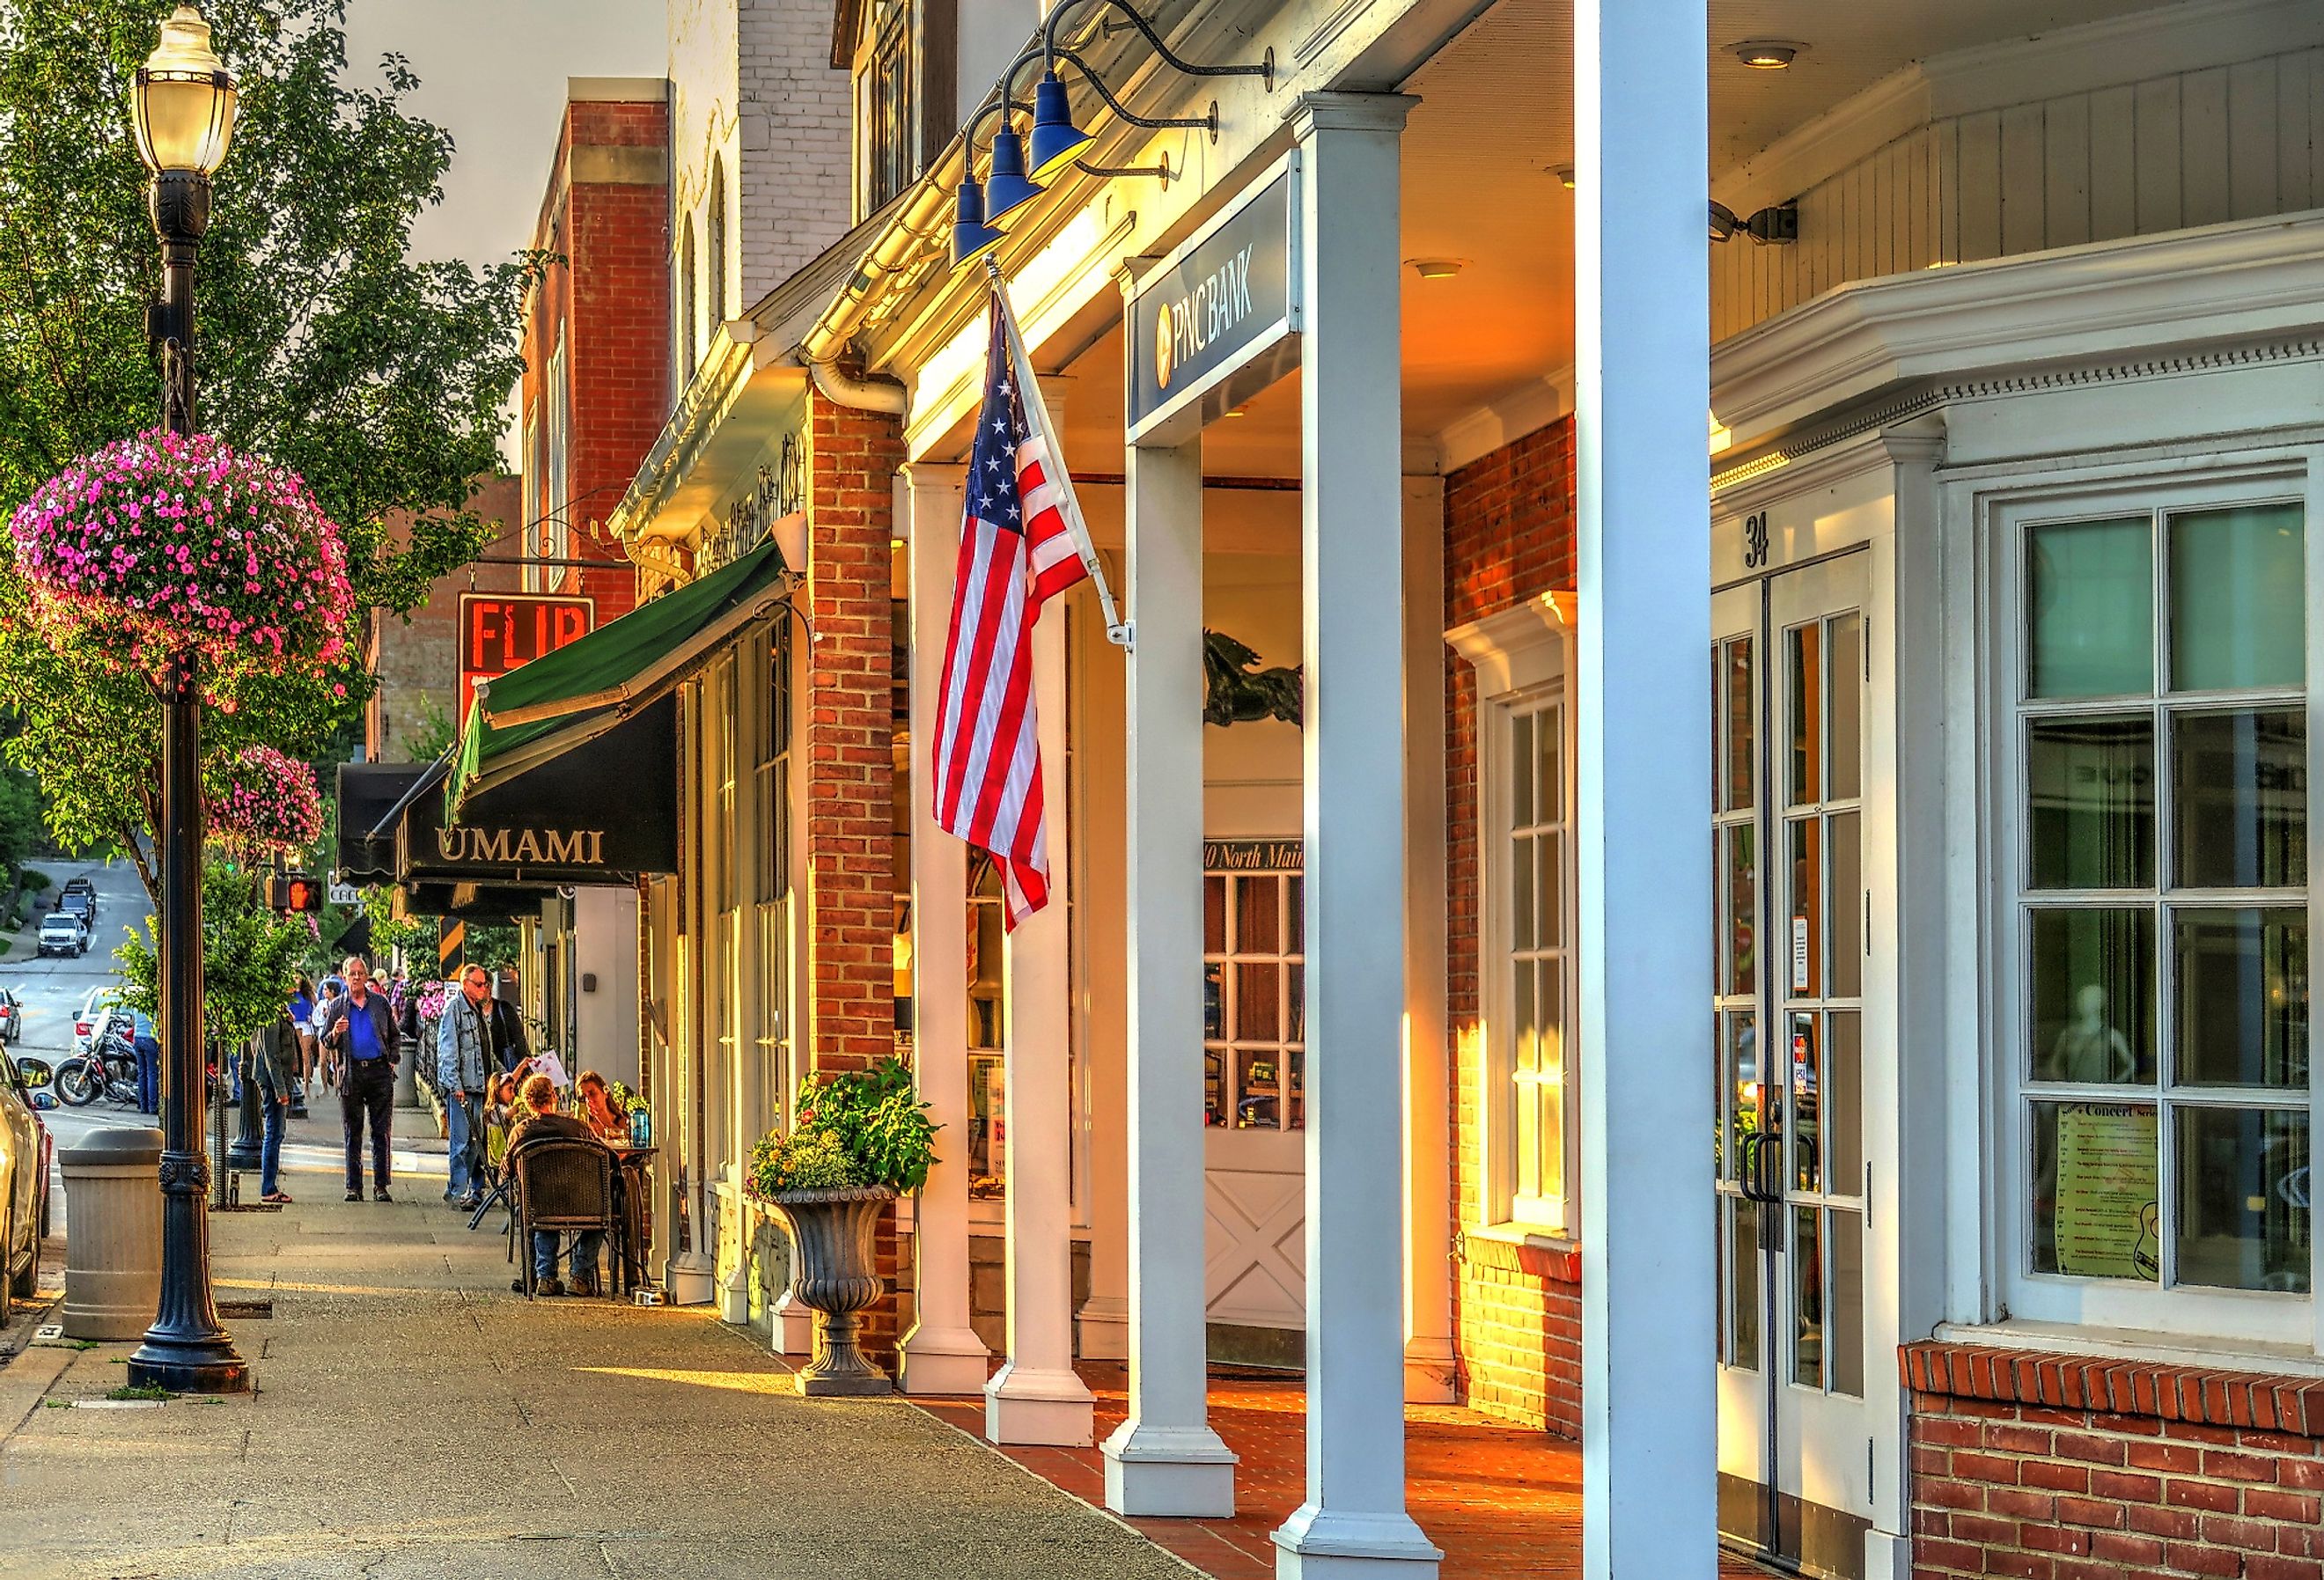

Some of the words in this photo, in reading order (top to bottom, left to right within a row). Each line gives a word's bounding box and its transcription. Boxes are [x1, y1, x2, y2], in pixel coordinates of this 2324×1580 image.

[1173, 283, 1207, 369] PNC
[1207, 242, 1254, 344] BANK
[1745, 511, 1769, 568] 34
[435, 827, 605, 864] UMAMI
[1218, 844, 1261, 868] North
[2085, 1103, 2133, 1117] Concert
